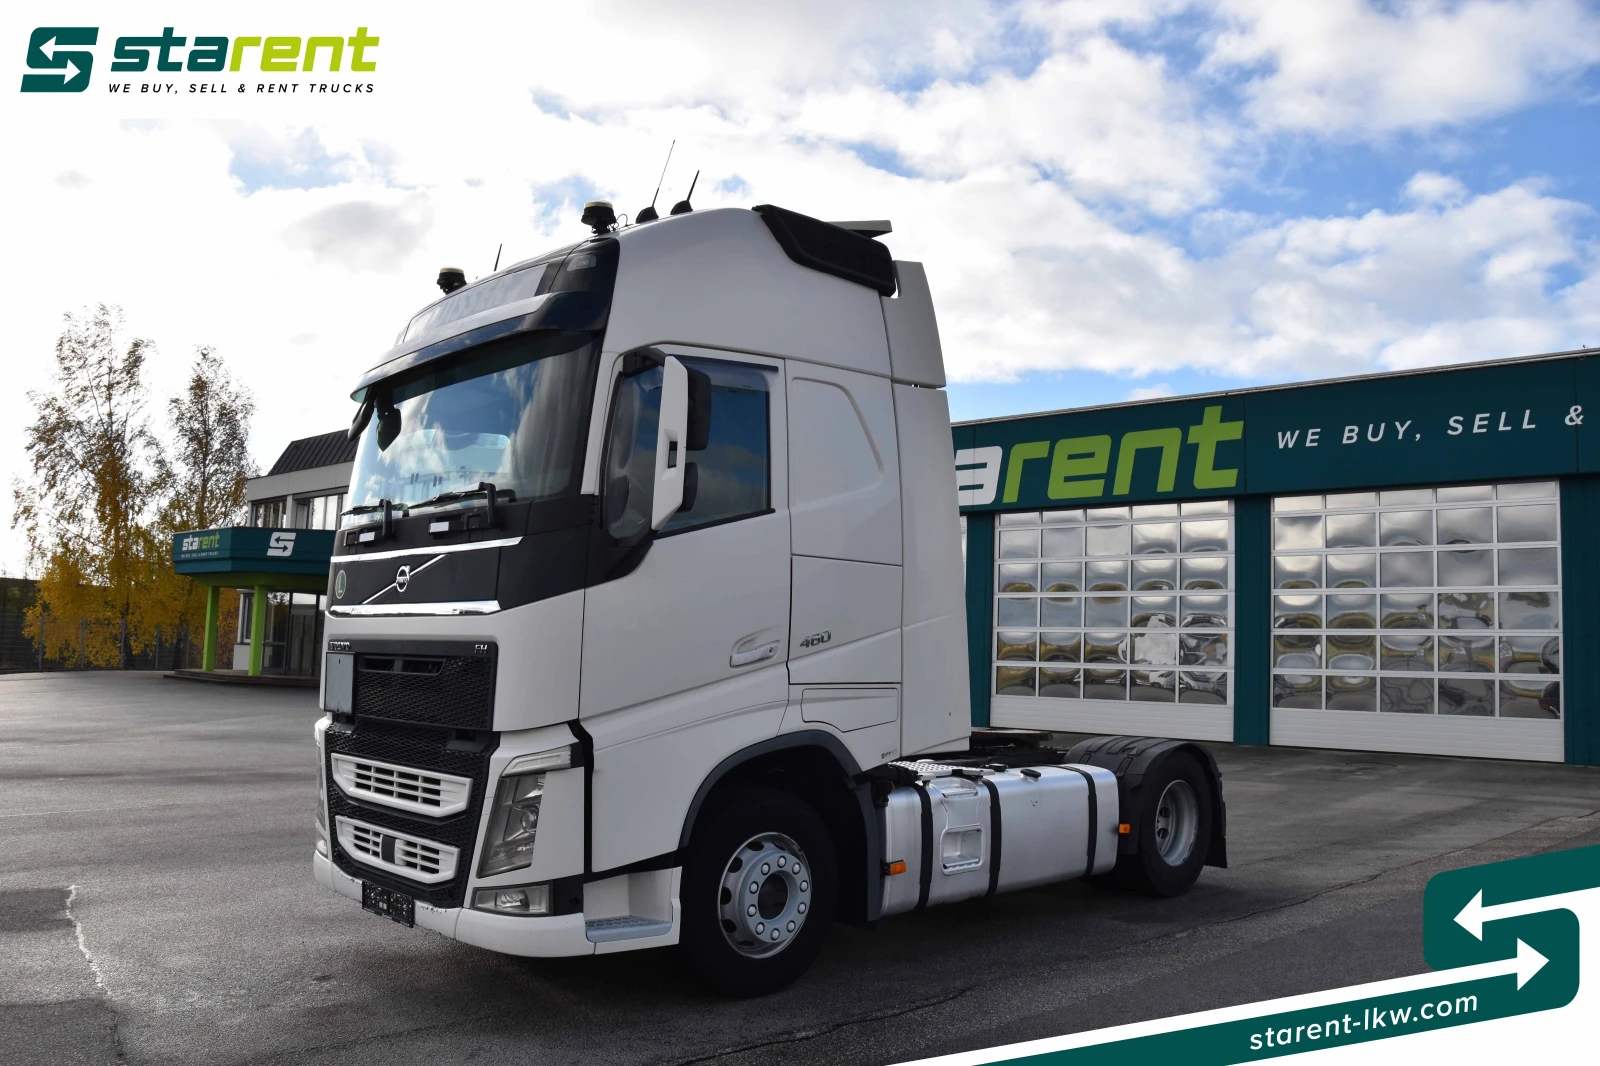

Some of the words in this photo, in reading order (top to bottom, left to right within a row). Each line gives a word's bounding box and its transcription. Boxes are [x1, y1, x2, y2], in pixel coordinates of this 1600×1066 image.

[1277, 428, 1321, 449] WE
[1342, 420, 1421, 444] BUY,
[1447, 409, 1537, 436] SELL
[1564, 405, 1584, 426] &
[182, 531, 220, 551] starent
[800, 629, 832, 648] 460
